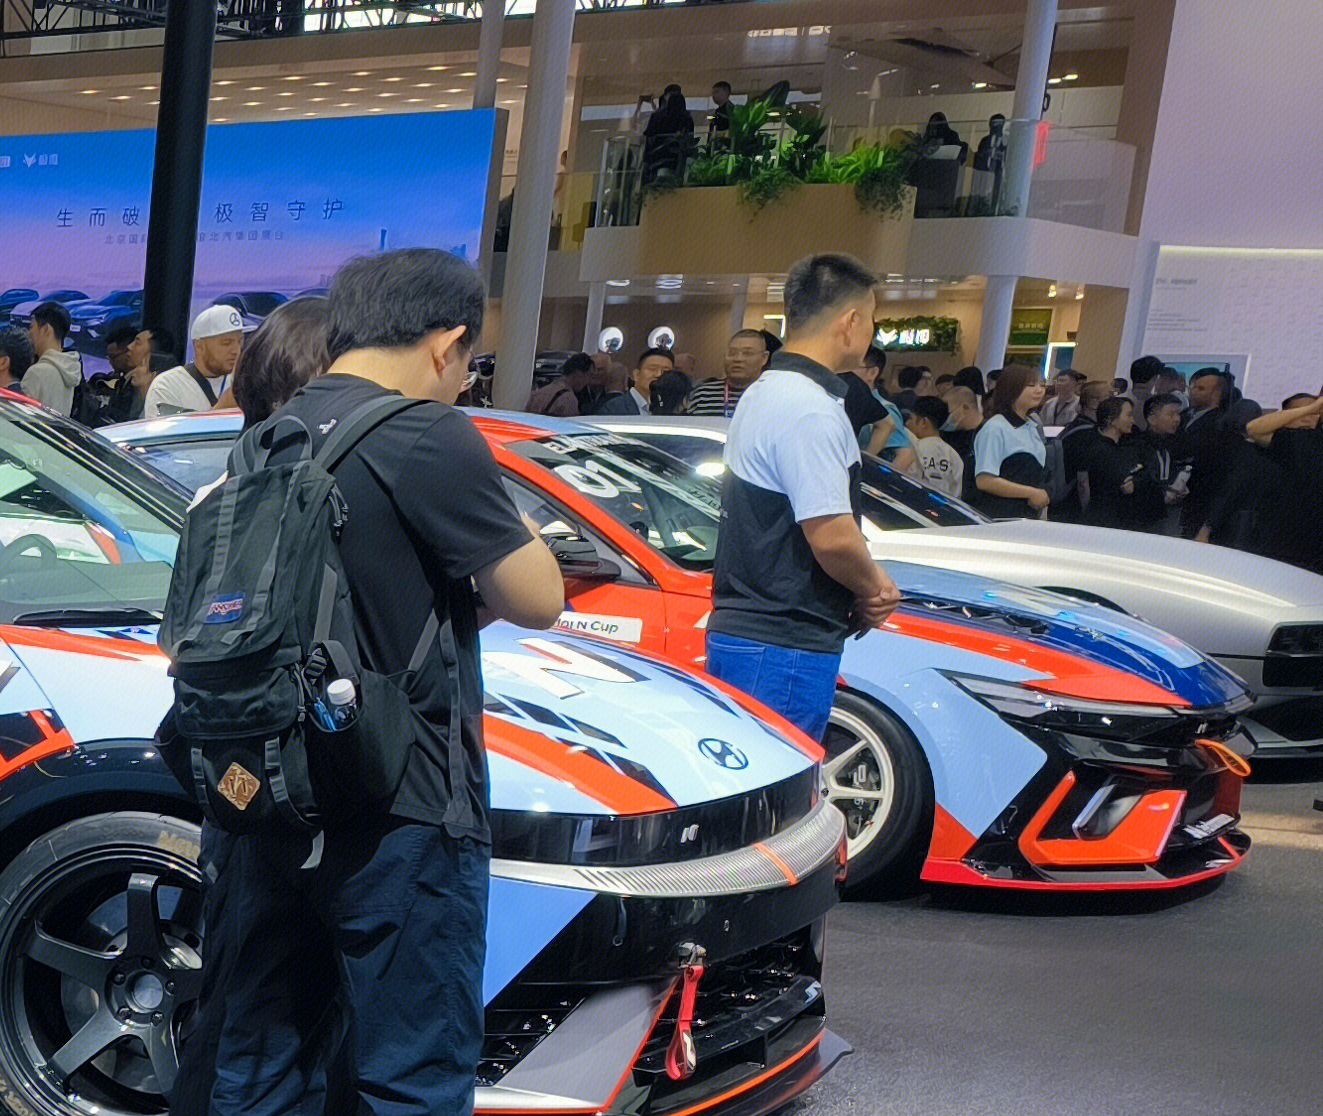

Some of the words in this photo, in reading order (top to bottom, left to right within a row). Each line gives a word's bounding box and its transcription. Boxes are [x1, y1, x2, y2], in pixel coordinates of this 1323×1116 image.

[214, 198, 344, 223] 极智守护
[576, 621, 588, 630] N
[590, 620, 619, 635] Cup
